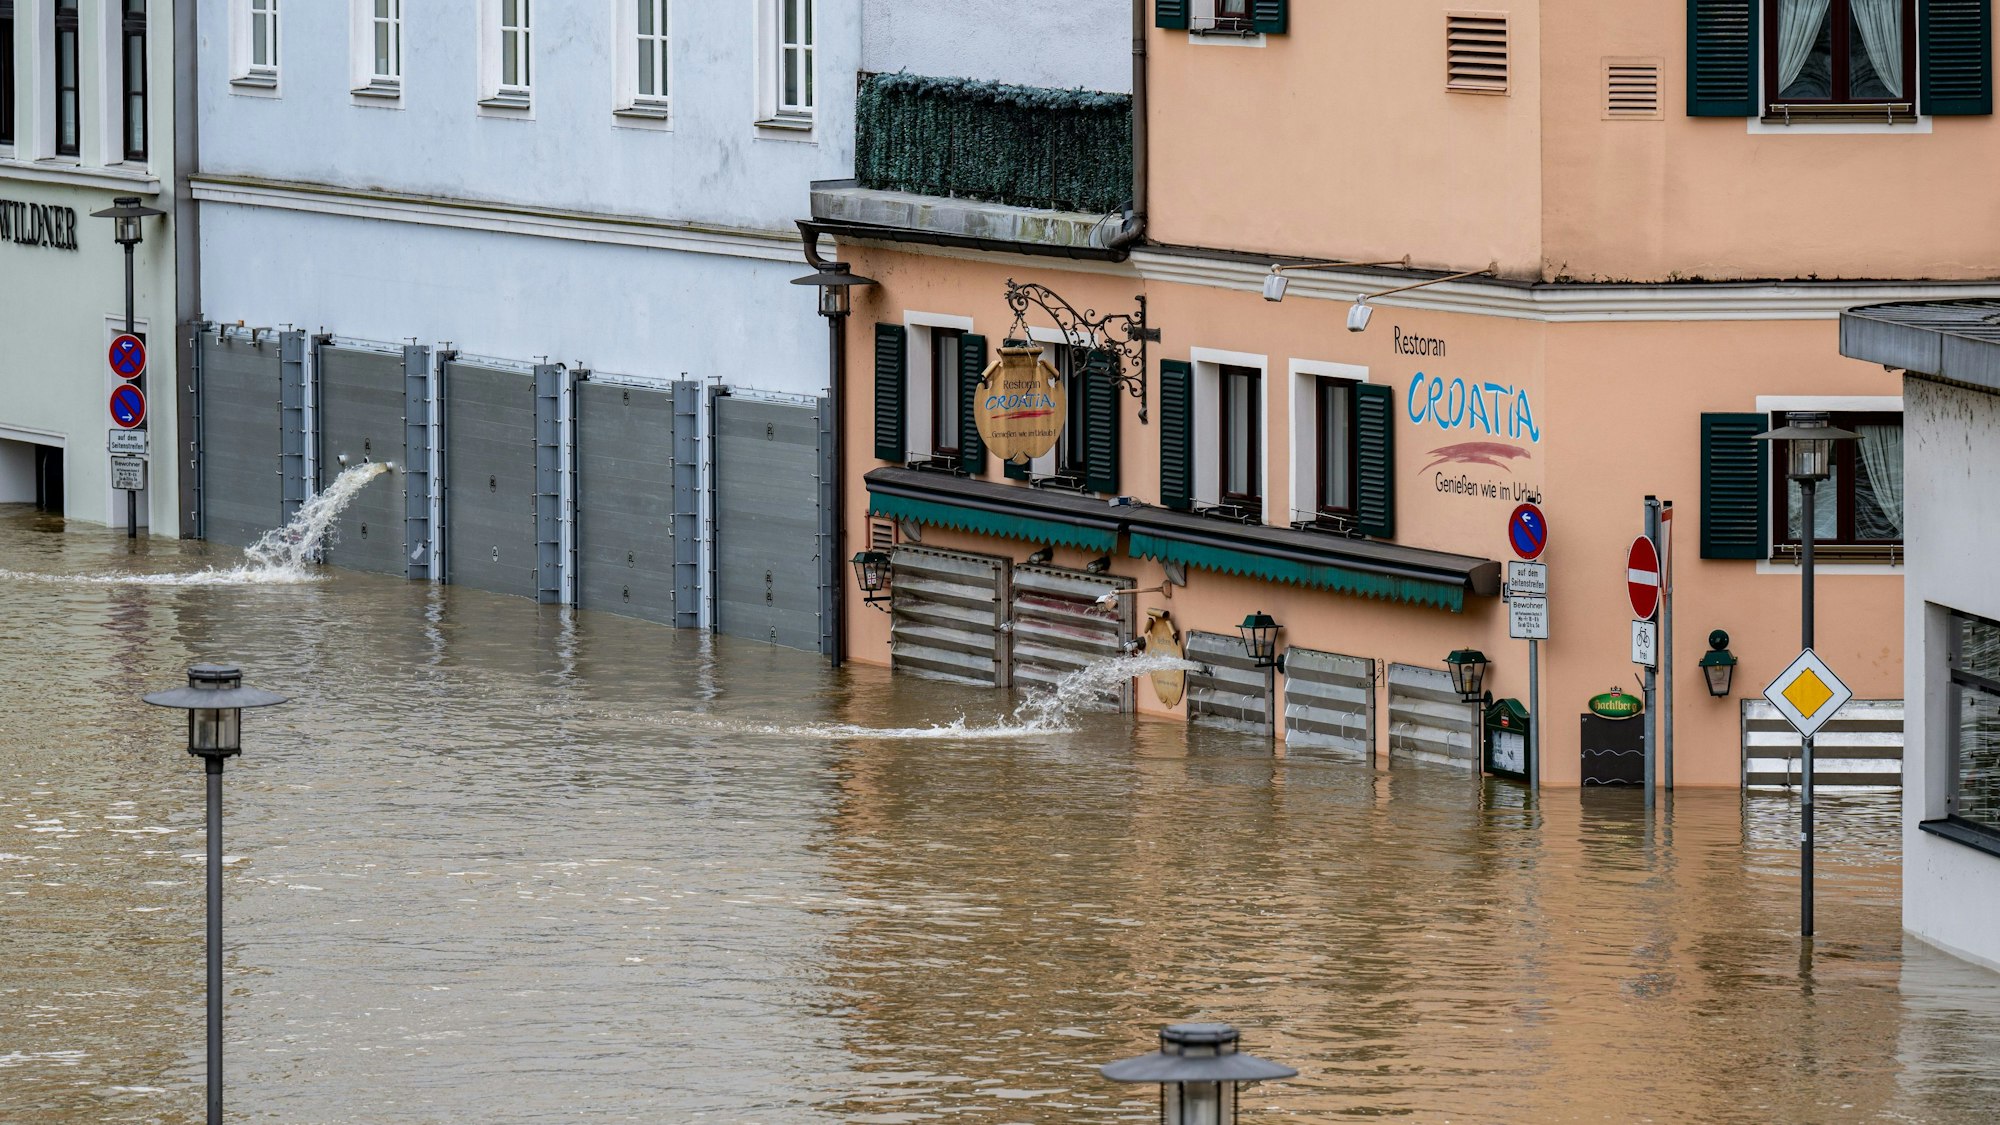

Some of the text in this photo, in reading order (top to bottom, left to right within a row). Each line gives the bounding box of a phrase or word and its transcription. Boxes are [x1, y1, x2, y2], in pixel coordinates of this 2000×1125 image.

[0, 199, 78, 251] WILDNER
[1394, 325, 1446, 357] Restoran
[1003, 379, 1041, 390] Restoran
[111, 441, 144, 450] Seitenstreifen
[1435, 471, 1478, 497] Genießen
[1480, 479, 1497, 499] wie
[1499, 481, 1511, 501] im
[1517, 568, 1539, 577] auf dem
[1511, 577, 1545, 589] Seitenstreifen
[1513, 601, 1544, 609] Bewohner
[1639, 649, 1648, 660] frei
